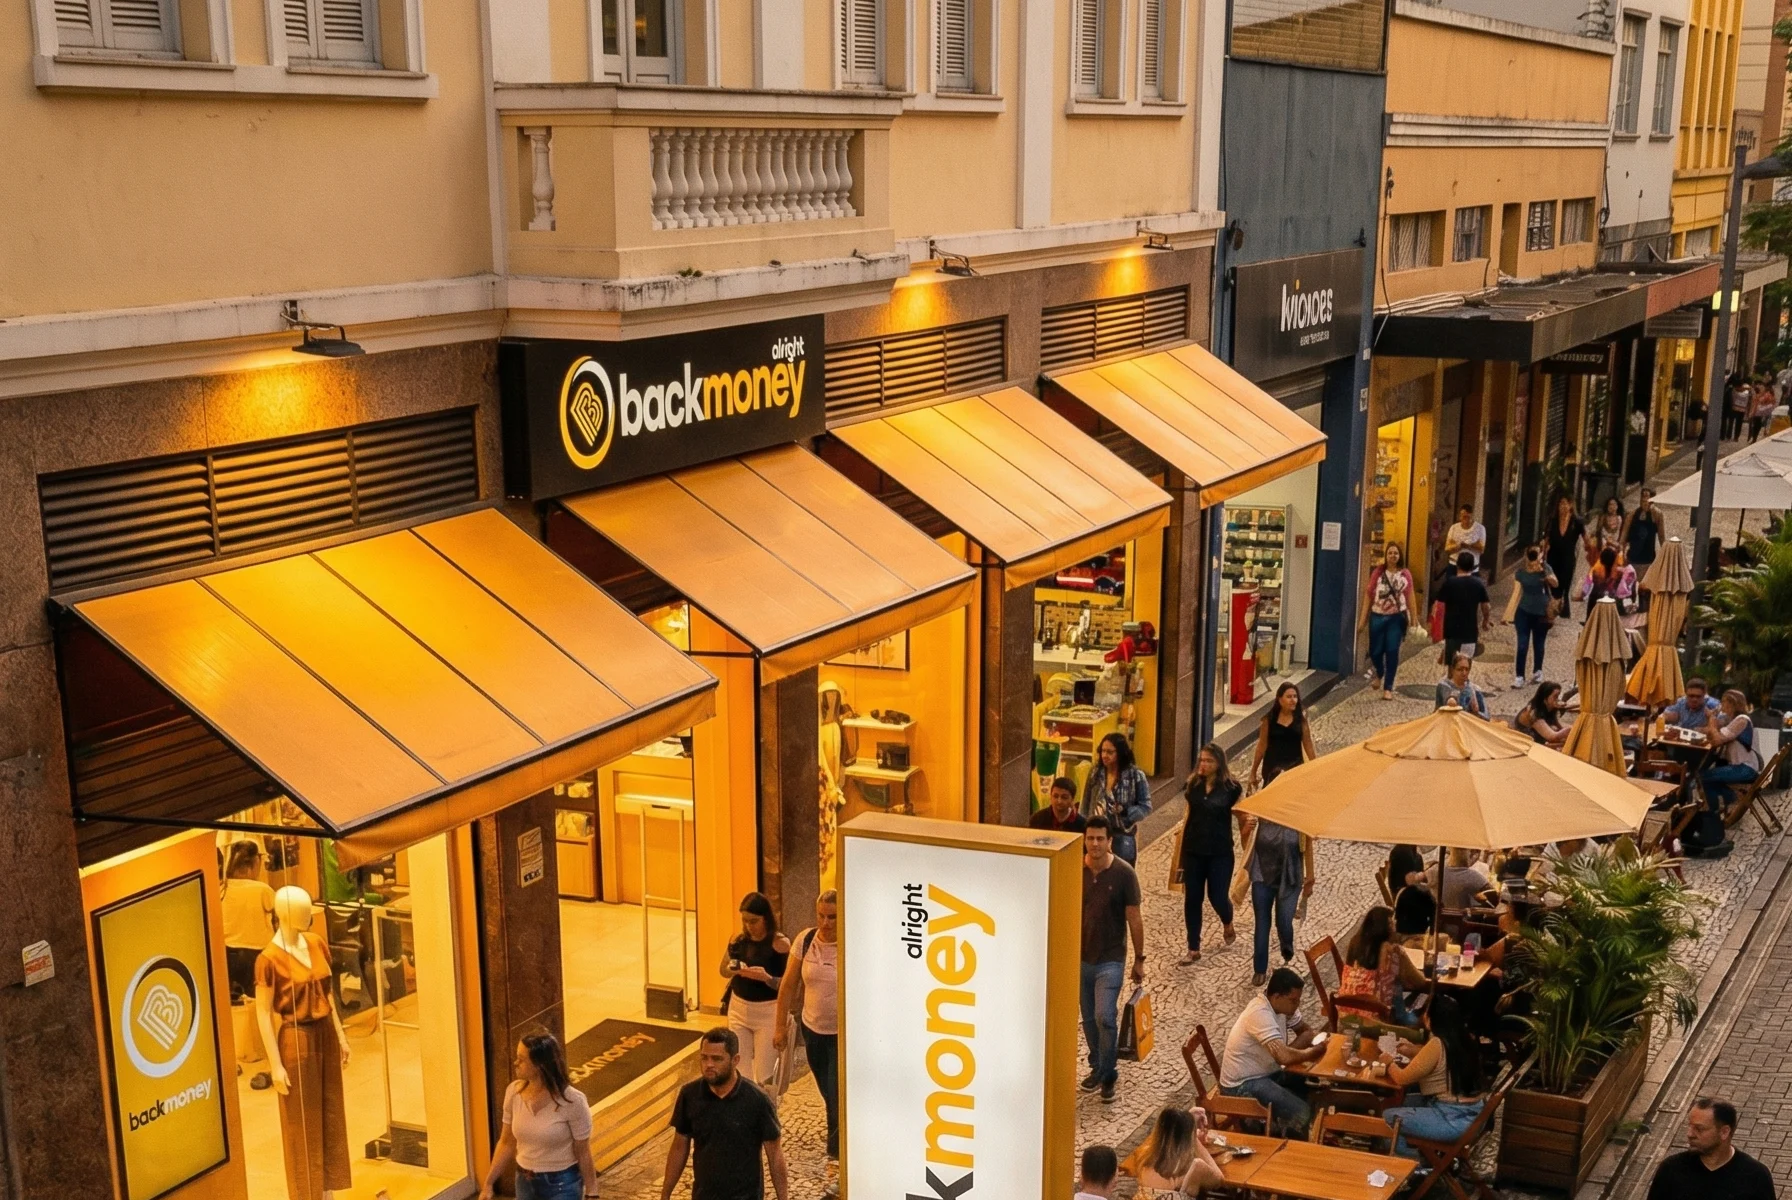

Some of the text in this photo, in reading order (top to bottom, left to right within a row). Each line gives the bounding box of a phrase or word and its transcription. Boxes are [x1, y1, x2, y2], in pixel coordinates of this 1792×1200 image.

[619, 362, 806, 437] backmoney
[900, 883, 929, 959] alright
[129, 1078, 213, 1132] backmoney
